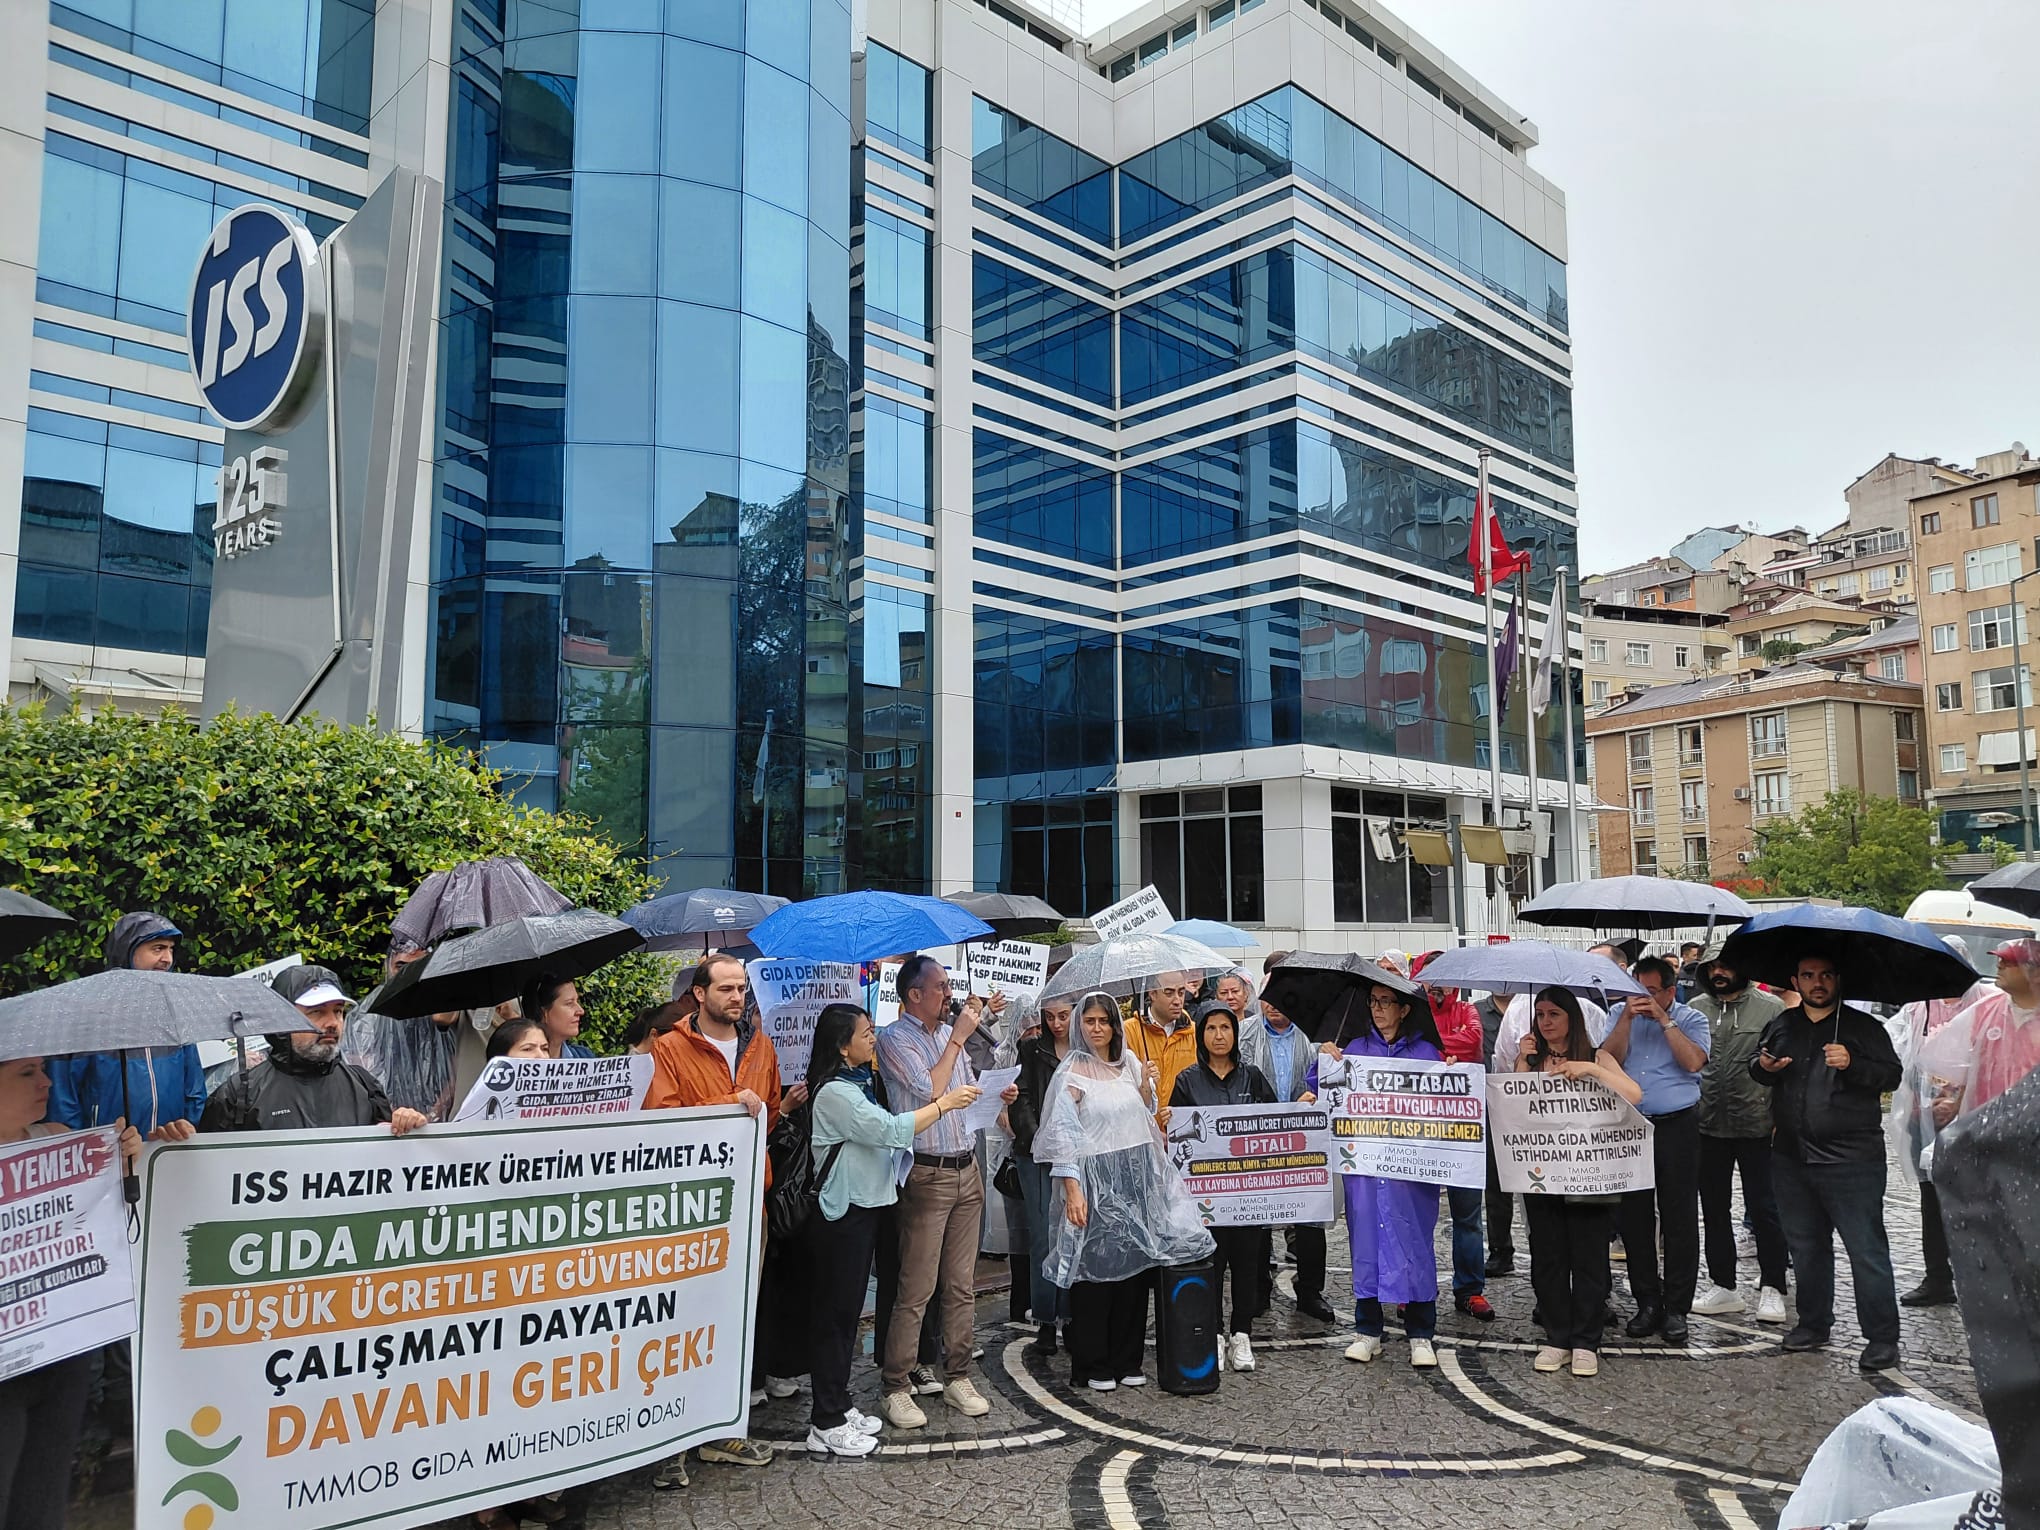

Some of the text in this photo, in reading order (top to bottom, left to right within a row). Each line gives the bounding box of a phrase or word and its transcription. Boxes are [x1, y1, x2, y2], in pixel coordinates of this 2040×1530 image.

[212, 446, 284, 530] 125
[214, 518, 275, 559] YEARS
[1002, 943, 1031, 955] TABAN
[969, 951, 1041, 972] ÜCRET HAKKIMIZ
[760, 965, 793, 981] GIDA
[992, 970, 1034, 985] EDİLEMEZ
[774, 1016, 798, 1032] GIDA
[517, 1057, 632, 1078] ISS HAZIR YEMEK
[515, 1076, 559, 1092] ÜRETİM
[562, 1081, 573, 1090] ve
[577, 1074, 612, 1089] HİZMET
[1372, 1073, 1466, 1094] ÇZP TABAN
[1504, 1081, 1539, 1095] GIDA
[553, 1093, 583, 1105] KİMYA
[597, 1089, 630, 1100] ZİRAAT
[1350, 1094, 1478, 1117] ÜCRET UYGULAMASI
[1529, 1098, 1617, 1115] ARTTIRILSIN!
[1218, 1115, 1326, 1135] ÇZP TABAN ÜCRET UYGULAMASI
[1336, 1120, 1481, 1140] HAKKIMIZ GASP EDİLEMEZ!
[1244, 1135, 1293, 1154] İPTALİ
[1503, 1126, 1647, 1146] KAMUDA GIDA MÜHENDİSİ
[1384, 1147, 1417, 1156] TMMOB
[1511, 1145, 1642, 1162] İSTİHDAMI ARTTIRILSIN!
[9, 1142, 93, 1193] YEMEK;
[231, 1142, 734, 1205] ISS HAZIR YEMEK ÜRETİM VE HİZMET A.Ş;
[1376, 1164, 1451, 1179] KOCAELİ ŞUBESİ
[1439, 1161, 1463, 1169] ODASI
[1205, 1178, 1240, 1191] KAYBINA
[1285, 1171, 1325, 1186] DEMEKTİR!
[1564, 1182, 1602, 1193] KOCAELİ
[1233, 1211, 1297, 1221] KOCAELİ ŞUBESİ
[229, 1183, 723, 1276] GIDA MÜHENDİSLERİNE
[194, 1233, 721, 1340] DÜŞÜK ÜCRETLE VE GÜVENCESİZ
[265, 1290, 677, 1396] ÇALIŞMAYI DAYATAN
[266, 1324, 716, 1458] DAVANI GERİ ÇEK!
[283, 1396, 686, 1509] TMMOB GIDA MÜHENDİSLERİ ODASI
